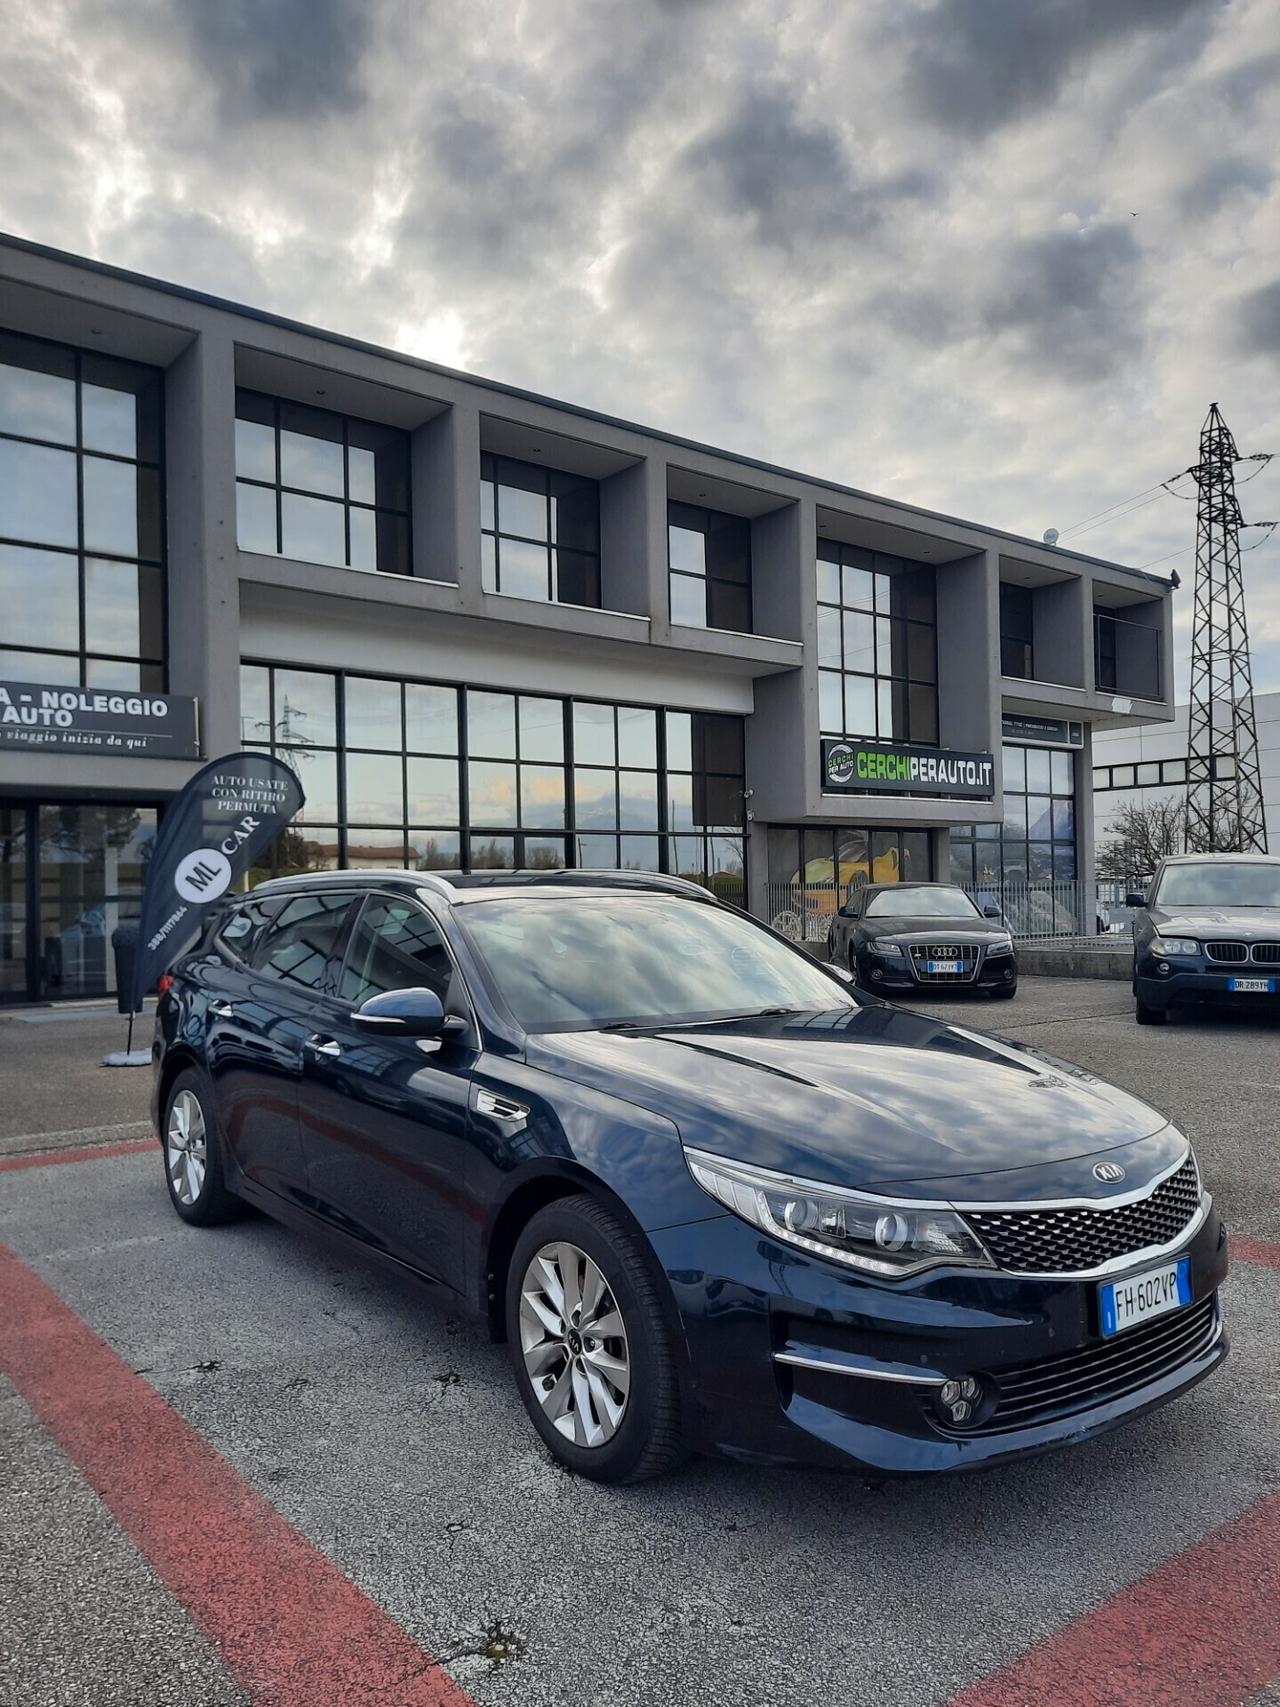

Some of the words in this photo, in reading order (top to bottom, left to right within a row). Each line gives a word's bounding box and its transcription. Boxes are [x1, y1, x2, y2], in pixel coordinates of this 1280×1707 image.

[41, 691, 168, 717] NOLEGGIO
[2, 705, 73, 727] AUTO
[7, 729, 57, 745] viaggio
[62, 732, 102, 745] inizia
[107, 735, 122, 747] da
[126, 737, 147, 749] qui
[212, 775, 246, 786] AUTO
[249, 777, 289, 791] USATE
[211, 788, 238, 798] CON
[241, 789, 286, 803] RITIRO
[217, 800, 277, 814] PERMUTA
[185, 861, 222, 892] ML
[221, 816, 261, 855] CAR
[1096, 1164, 1123, 1180] KIA
